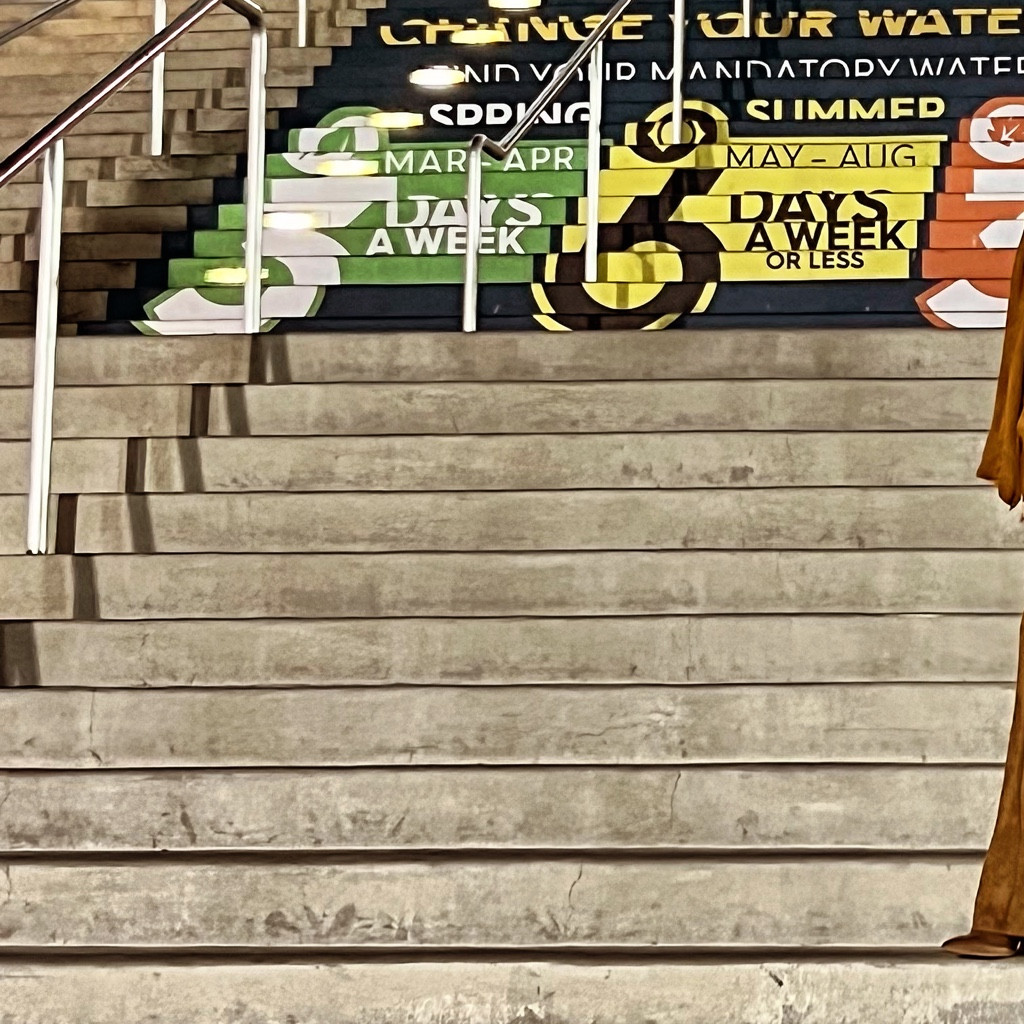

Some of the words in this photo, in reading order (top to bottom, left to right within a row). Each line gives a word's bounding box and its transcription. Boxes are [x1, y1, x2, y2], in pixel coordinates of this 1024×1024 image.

[650, 57, 901, 80] MANDATORY
[745, 96, 946, 120] SUMMER
[384, 148, 467, 175] MAR
[502, 145, 575, 173] APR
[726, 143, 803, 168] MAY
[839, 143, 917, 168] AUG
[385, 192, 556, 228] DAYS
[729, 189, 890, 224] DAYS
[366, 227, 396, 256] A
[404, 225, 527, 256] WEEK
[745, 221, 773, 252] A
[784, 219, 911, 252] WEEK
[765, 250, 801, 270] OR
[809, 250, 865, 269] LESS
